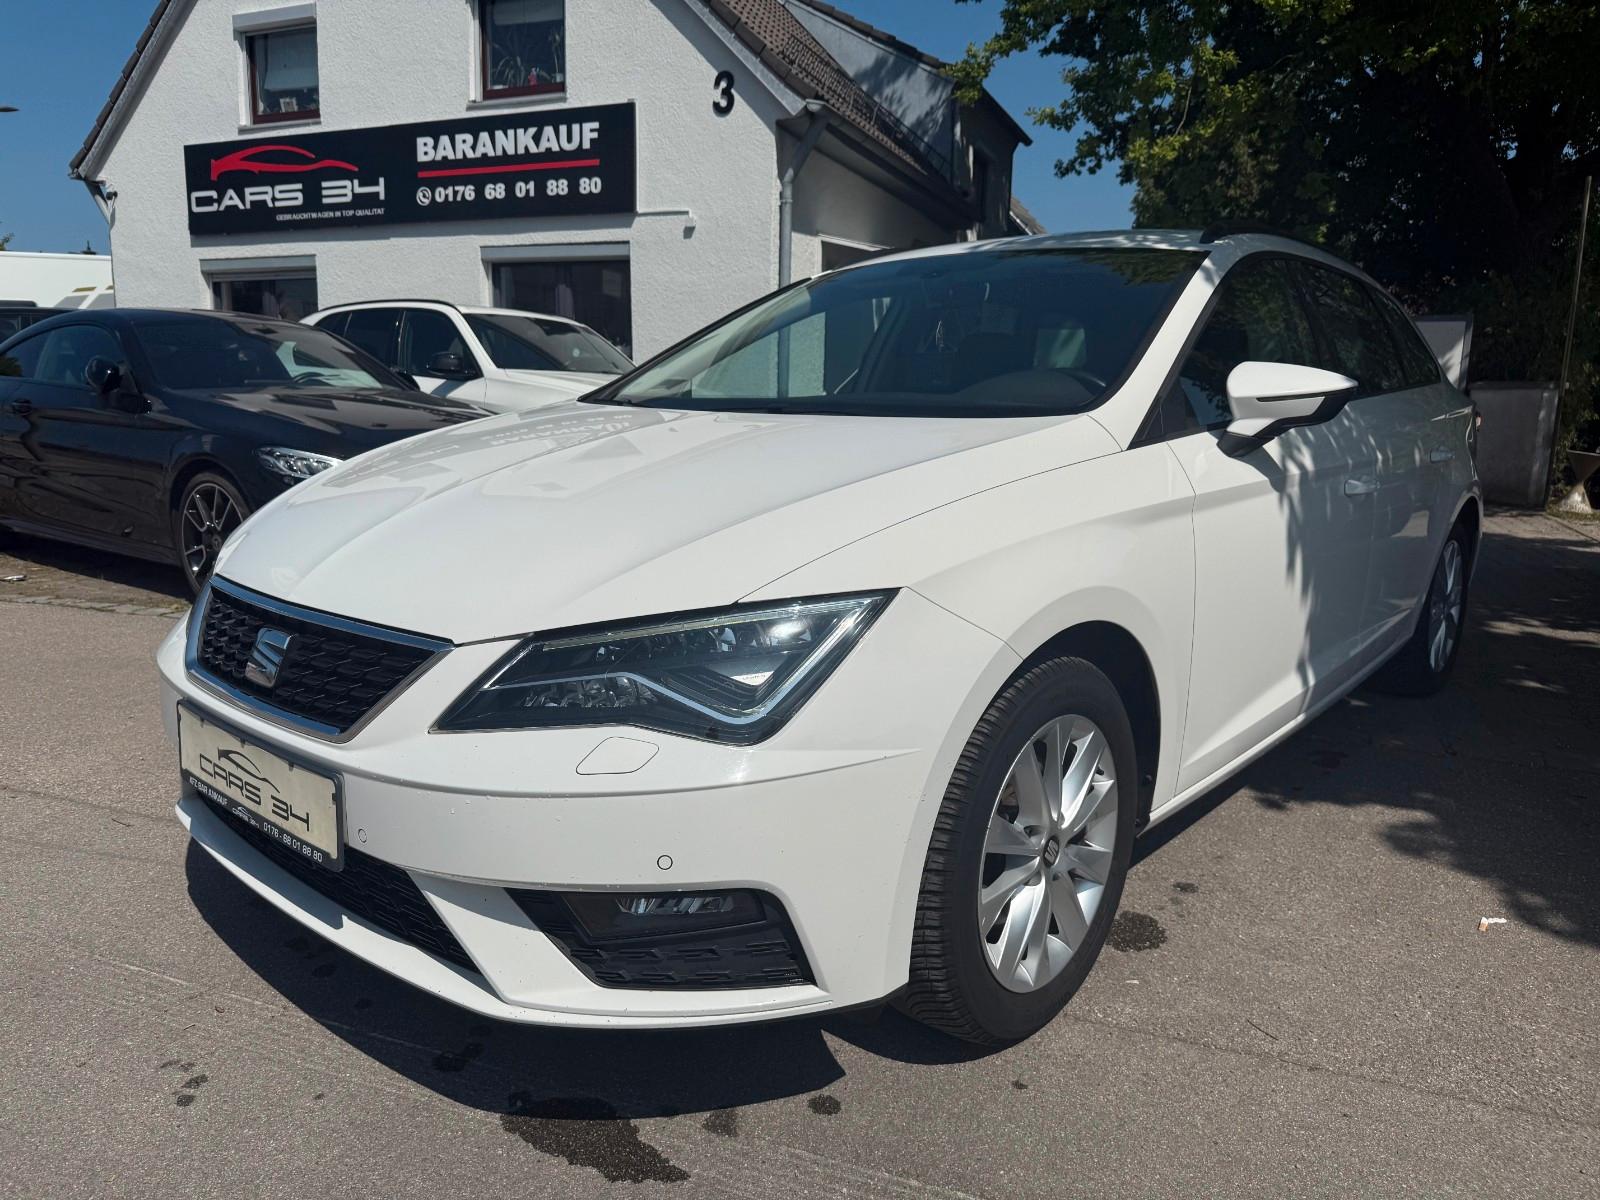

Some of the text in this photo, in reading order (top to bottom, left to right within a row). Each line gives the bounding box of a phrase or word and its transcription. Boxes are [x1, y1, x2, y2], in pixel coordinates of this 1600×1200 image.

[712, 70, 735, 118] 3
[416, 121, 600, 163] BARANKAUF
[190, 177, 385, 213] CARS 34
[434, 176, 602, 203] 0176 68 01 88 80
[276, 211, 334, 221] GEBRAUCHTWAGEN
[342, 209, 354, 217] TOP
[199, 753, 310, 832] CARS 34
[198, 782, 208, 795] BAR
[263, 821, 279, 838] 0176
[292, 839, 301, 851] 01
